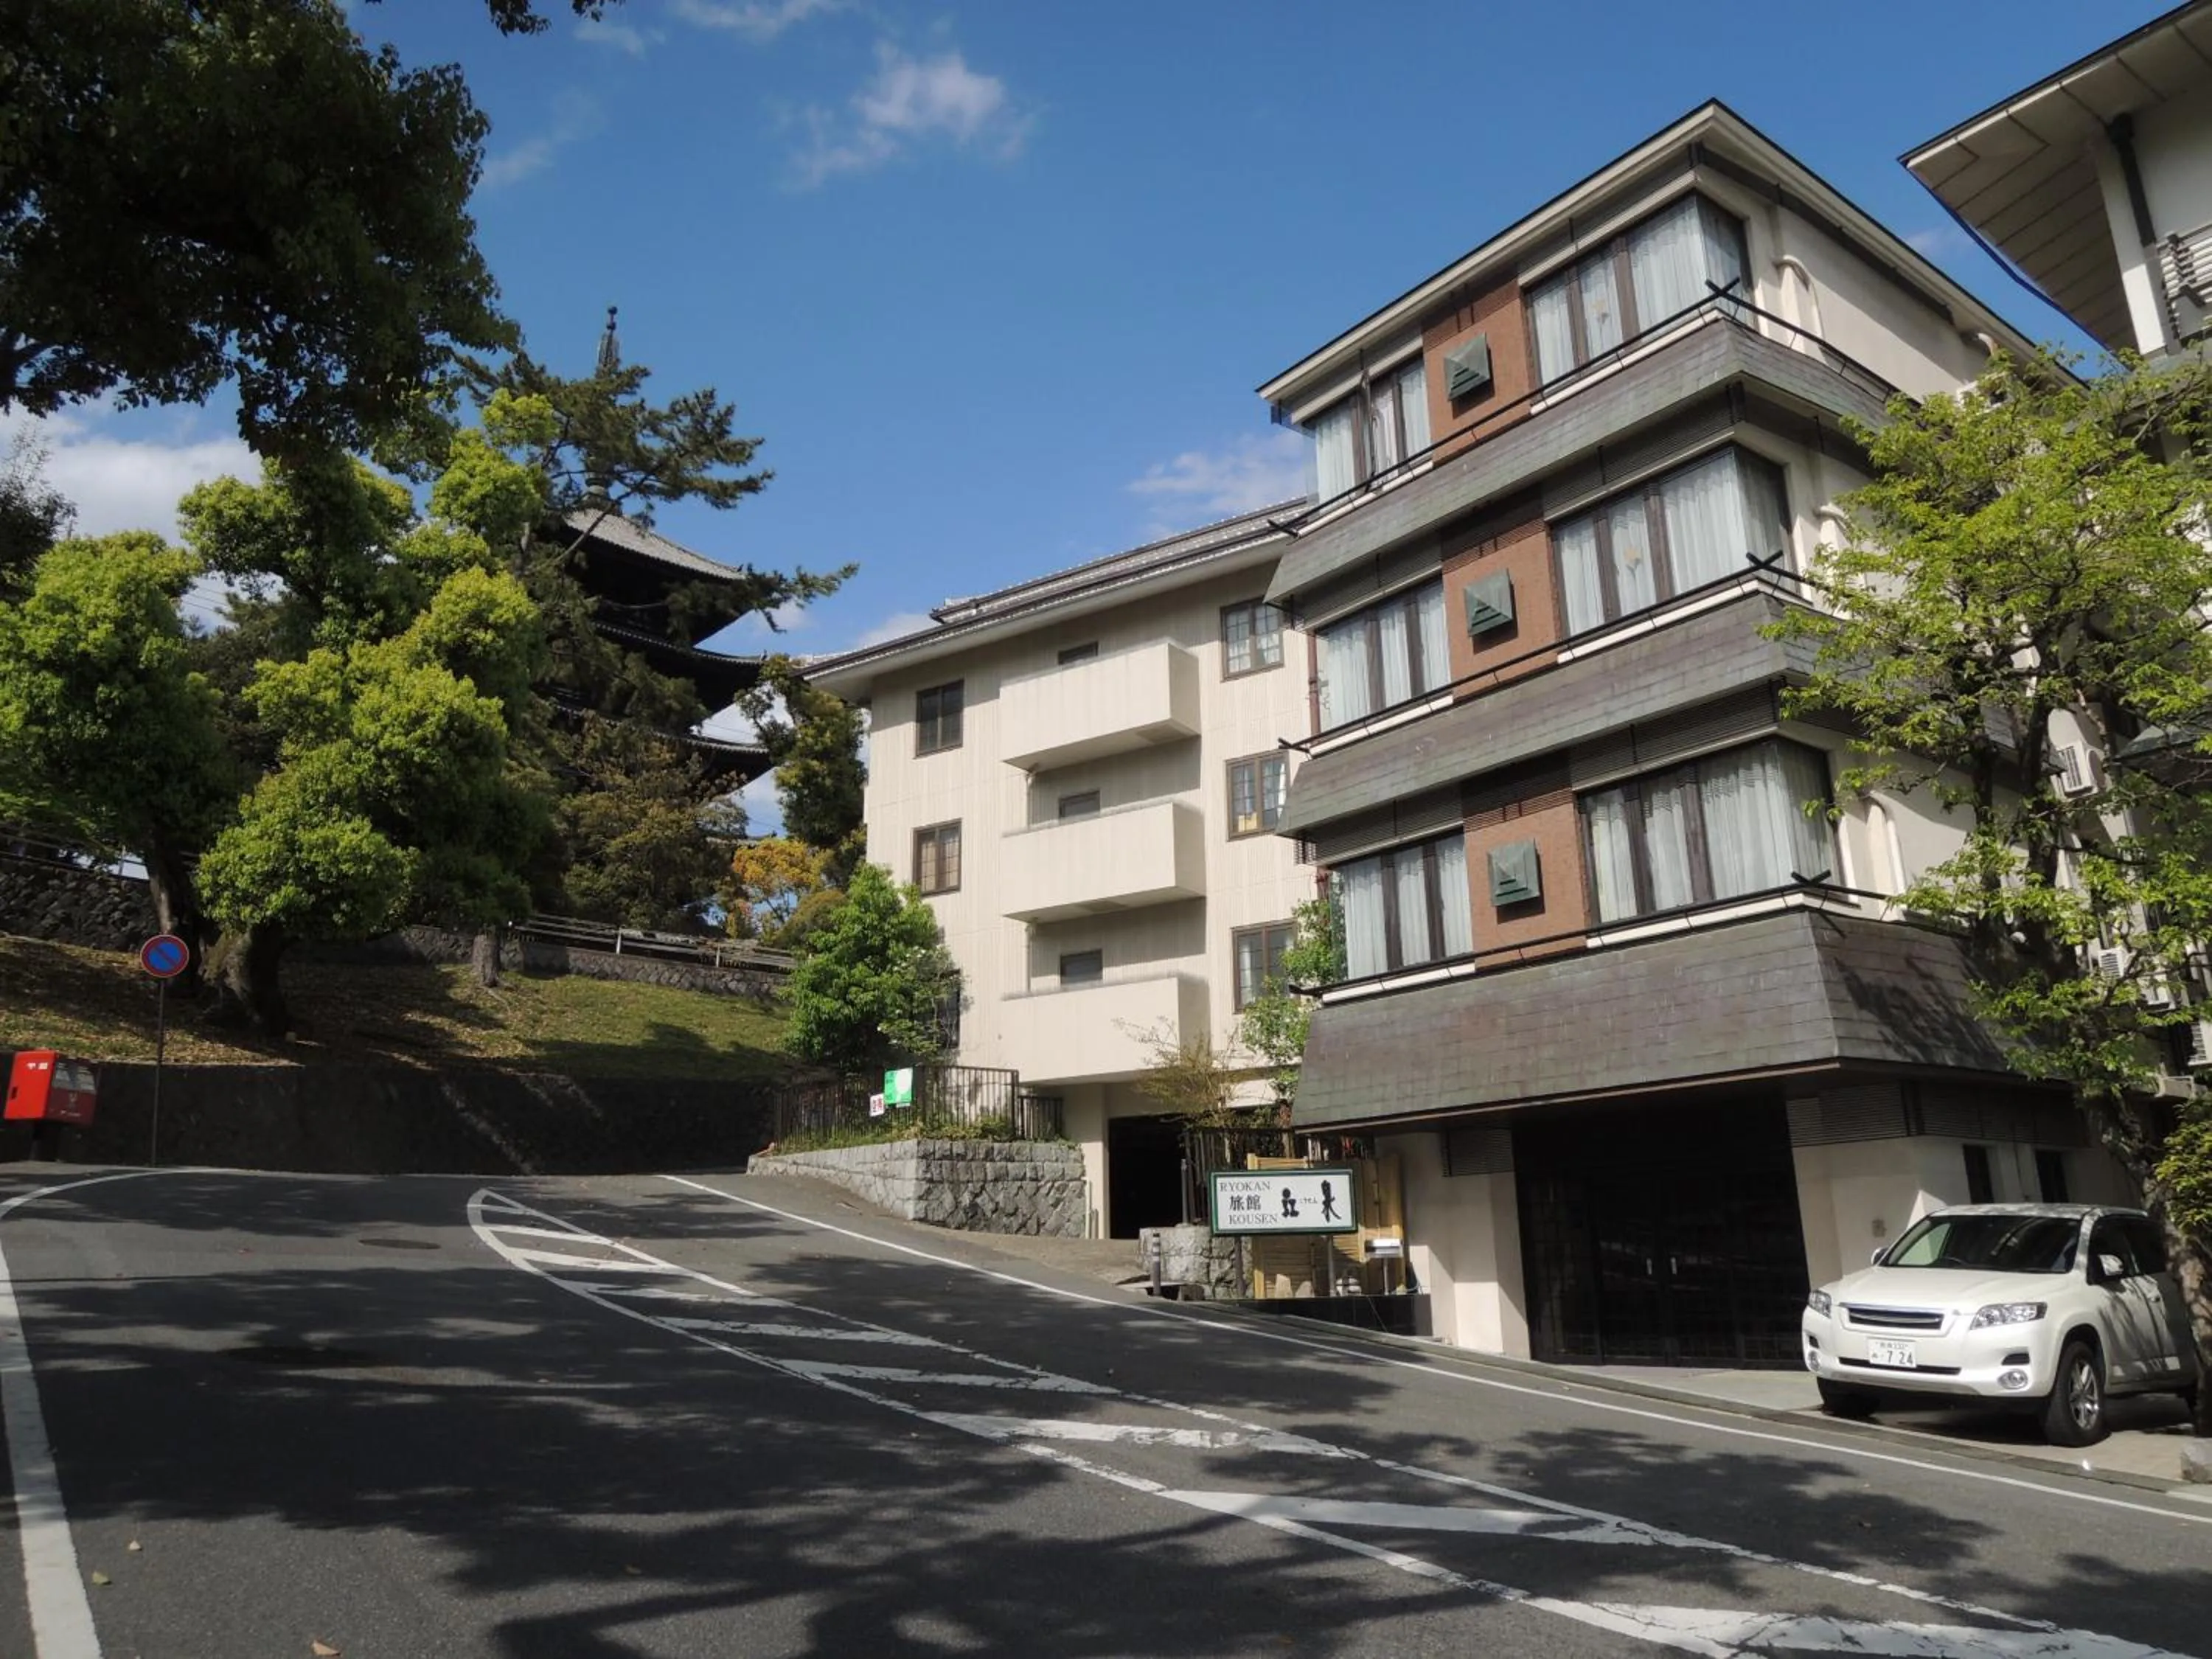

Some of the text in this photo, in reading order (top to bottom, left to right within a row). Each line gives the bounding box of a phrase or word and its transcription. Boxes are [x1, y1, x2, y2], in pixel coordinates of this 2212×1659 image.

[1219, 1181, 1270, 1192] RYOKAN
[1230, 1195, 1262, 1211] 旅館
[1228, 1214, 1277, 1225] KOUSEN
